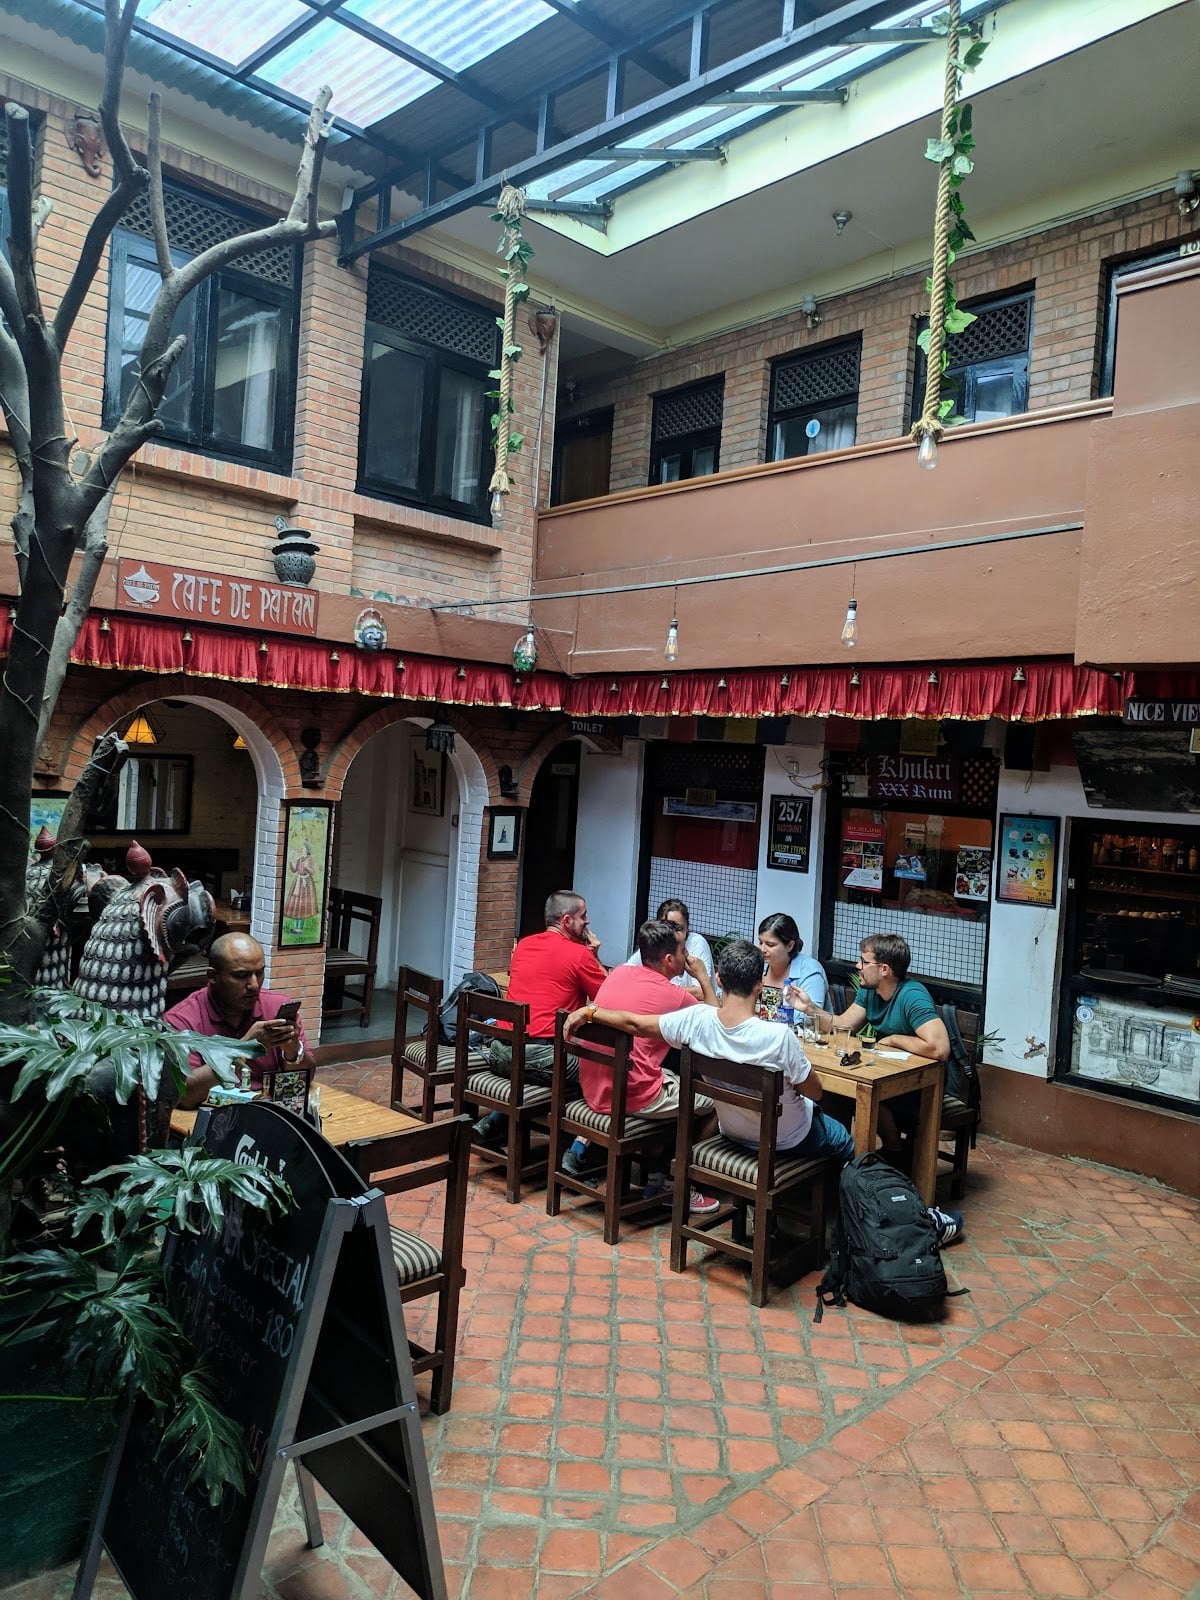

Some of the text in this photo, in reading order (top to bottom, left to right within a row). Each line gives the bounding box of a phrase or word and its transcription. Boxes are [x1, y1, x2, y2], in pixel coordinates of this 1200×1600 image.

[171, 573, 315, 629] CAFE DE PATAN
[1127, 702, 1200, 722] NICE VIE
[571, 720, 604, 733] TOILET
[878, 755, 951, 782] Khukri
[877, 782, 953, 800] XXX Rum
[778, 801, 803, 823] 25%
